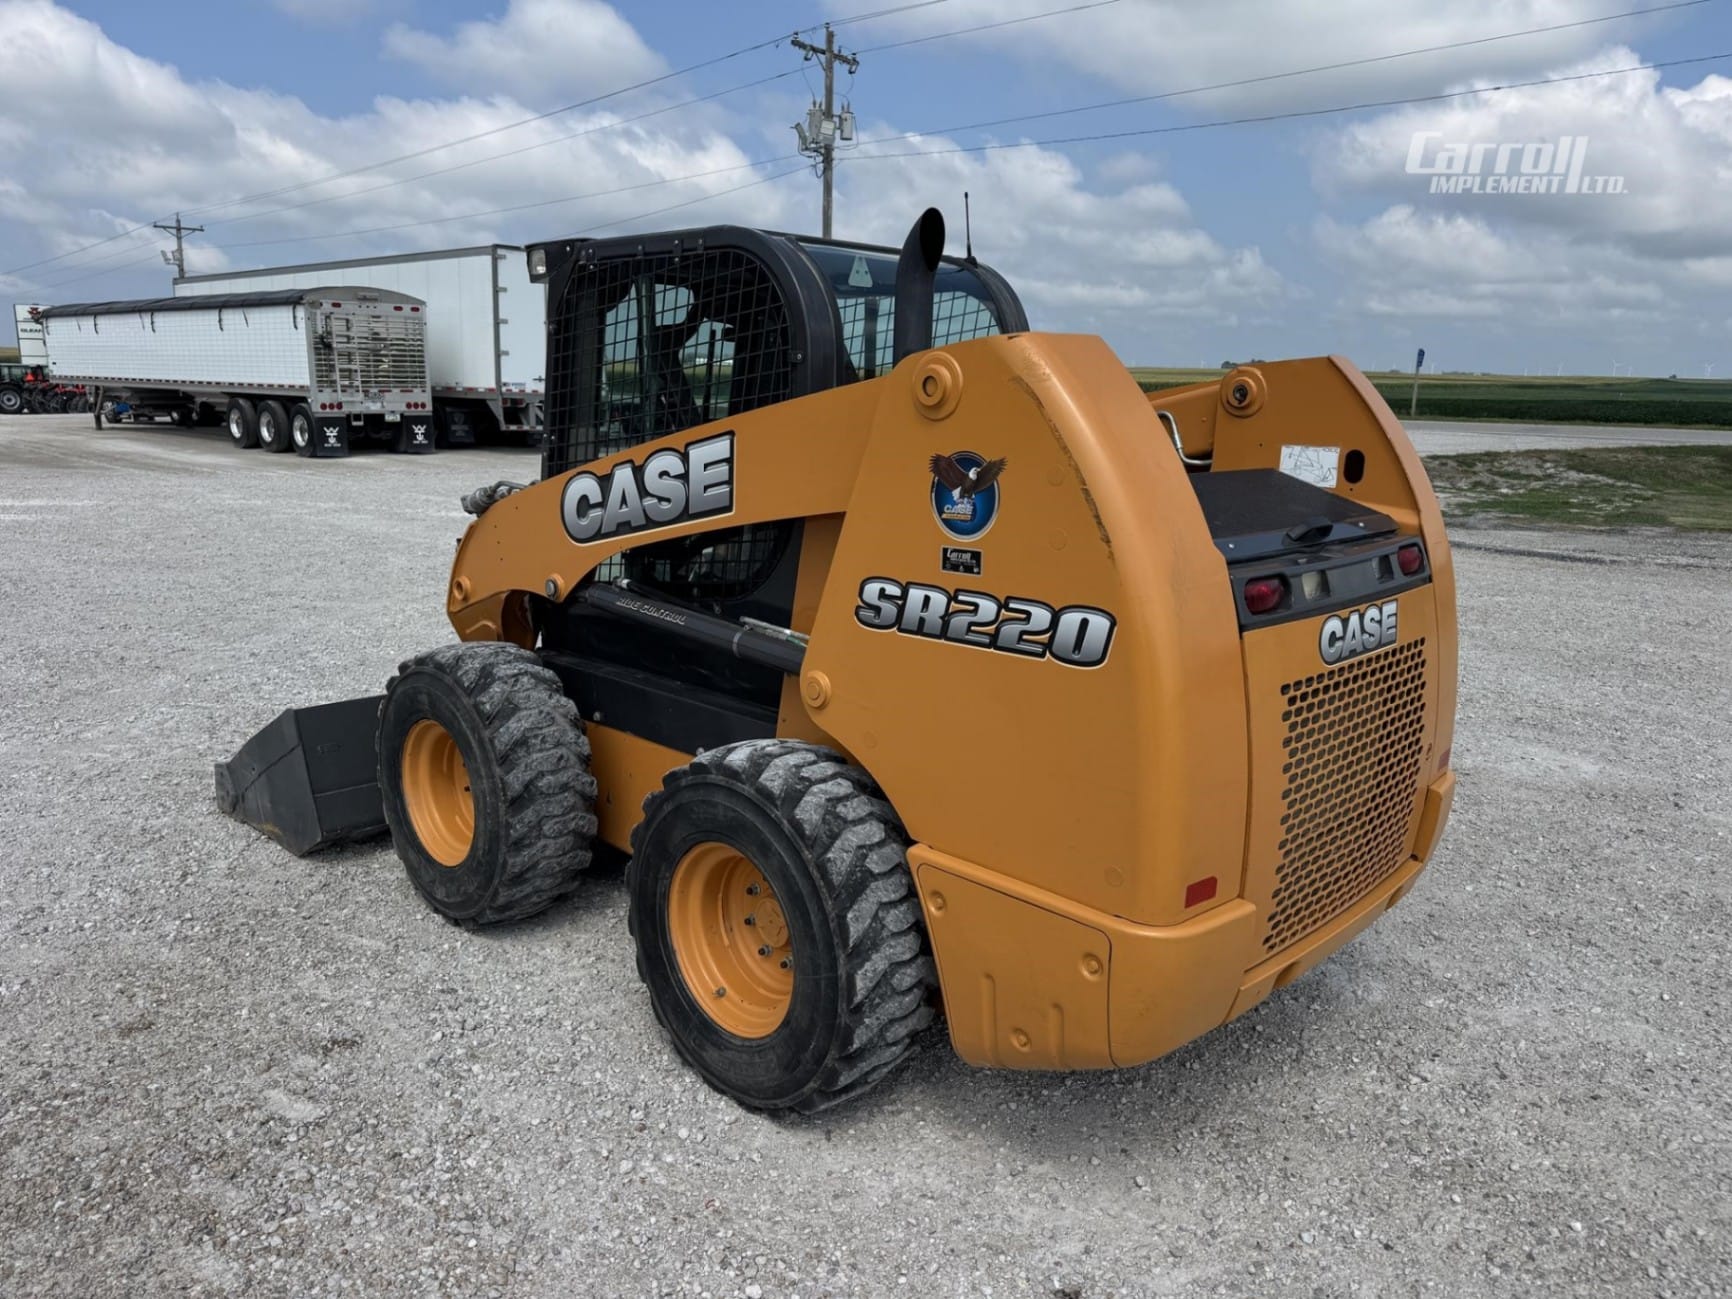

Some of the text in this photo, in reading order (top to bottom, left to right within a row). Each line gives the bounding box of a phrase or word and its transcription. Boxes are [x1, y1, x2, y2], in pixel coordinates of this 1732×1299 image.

[561, 431, 735, 543] CASE
[856, 577, 1116, 668] SR220
[1319, 599, 1397, 665] CASE
